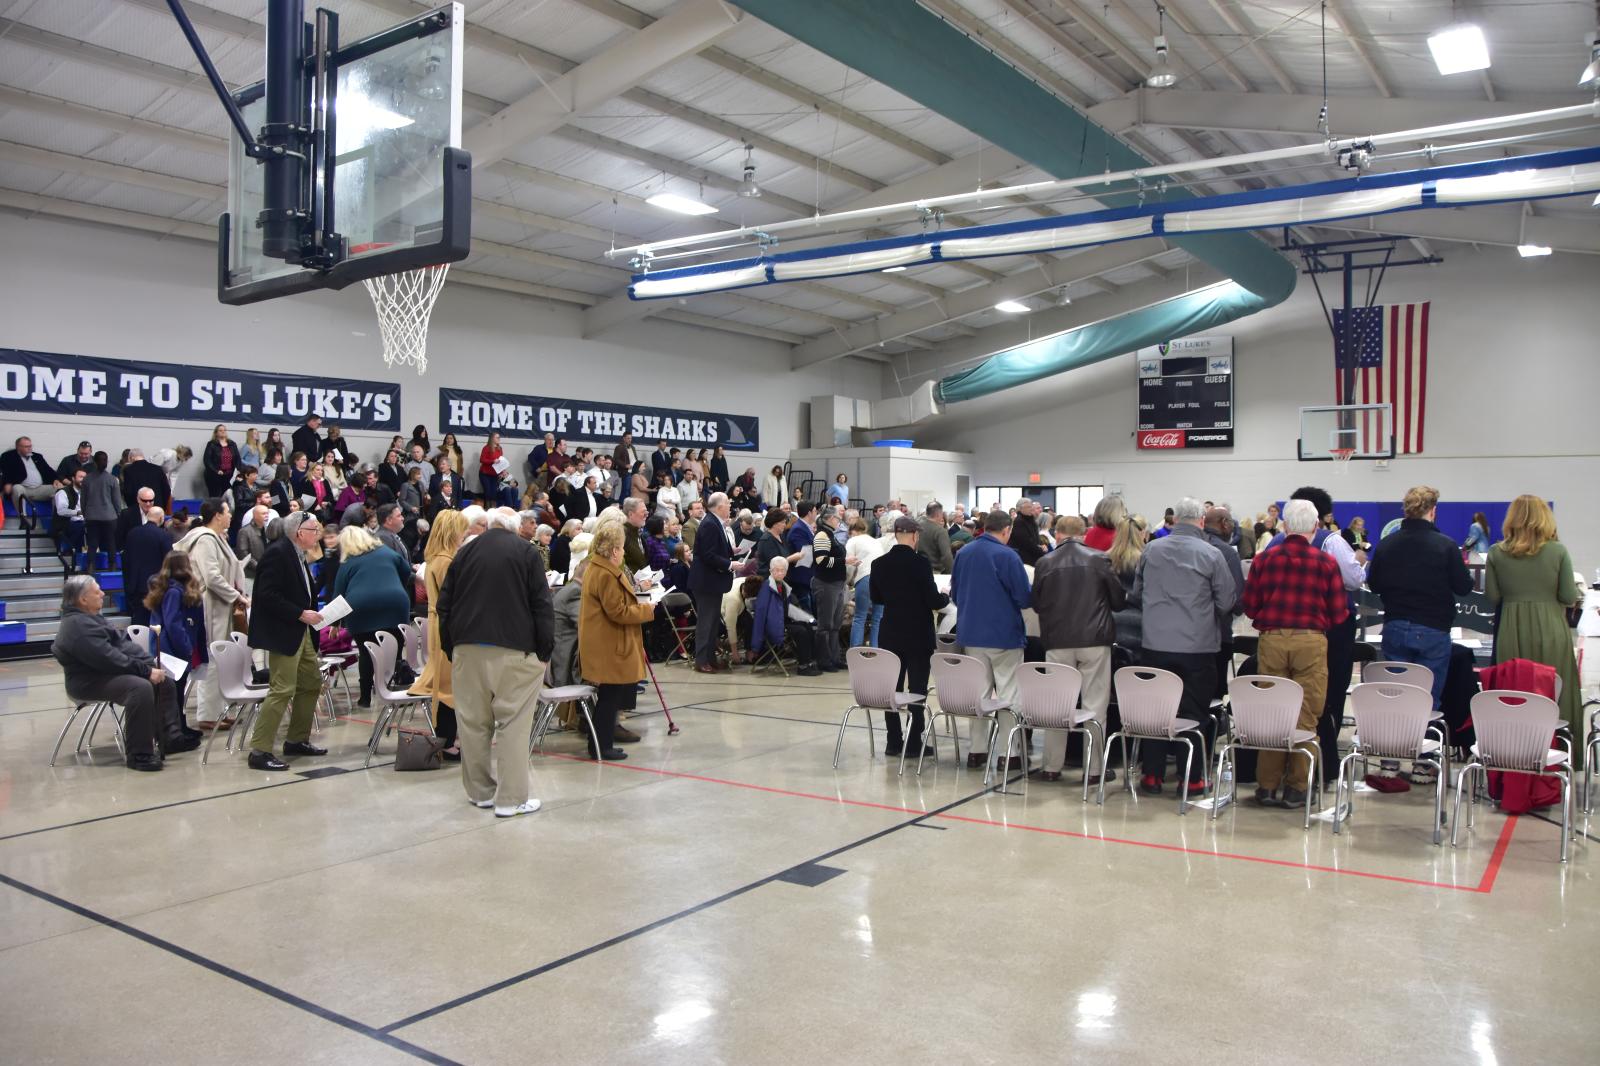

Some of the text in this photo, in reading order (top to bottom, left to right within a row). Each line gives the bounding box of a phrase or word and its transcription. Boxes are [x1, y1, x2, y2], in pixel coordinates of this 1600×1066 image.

[0, 363, 391, 422] OME TO ST. LUKE'S
[1204, 375, 1227, 384] GUEST
[449, 399, 718, 442] HOME OF THE SHARKS
